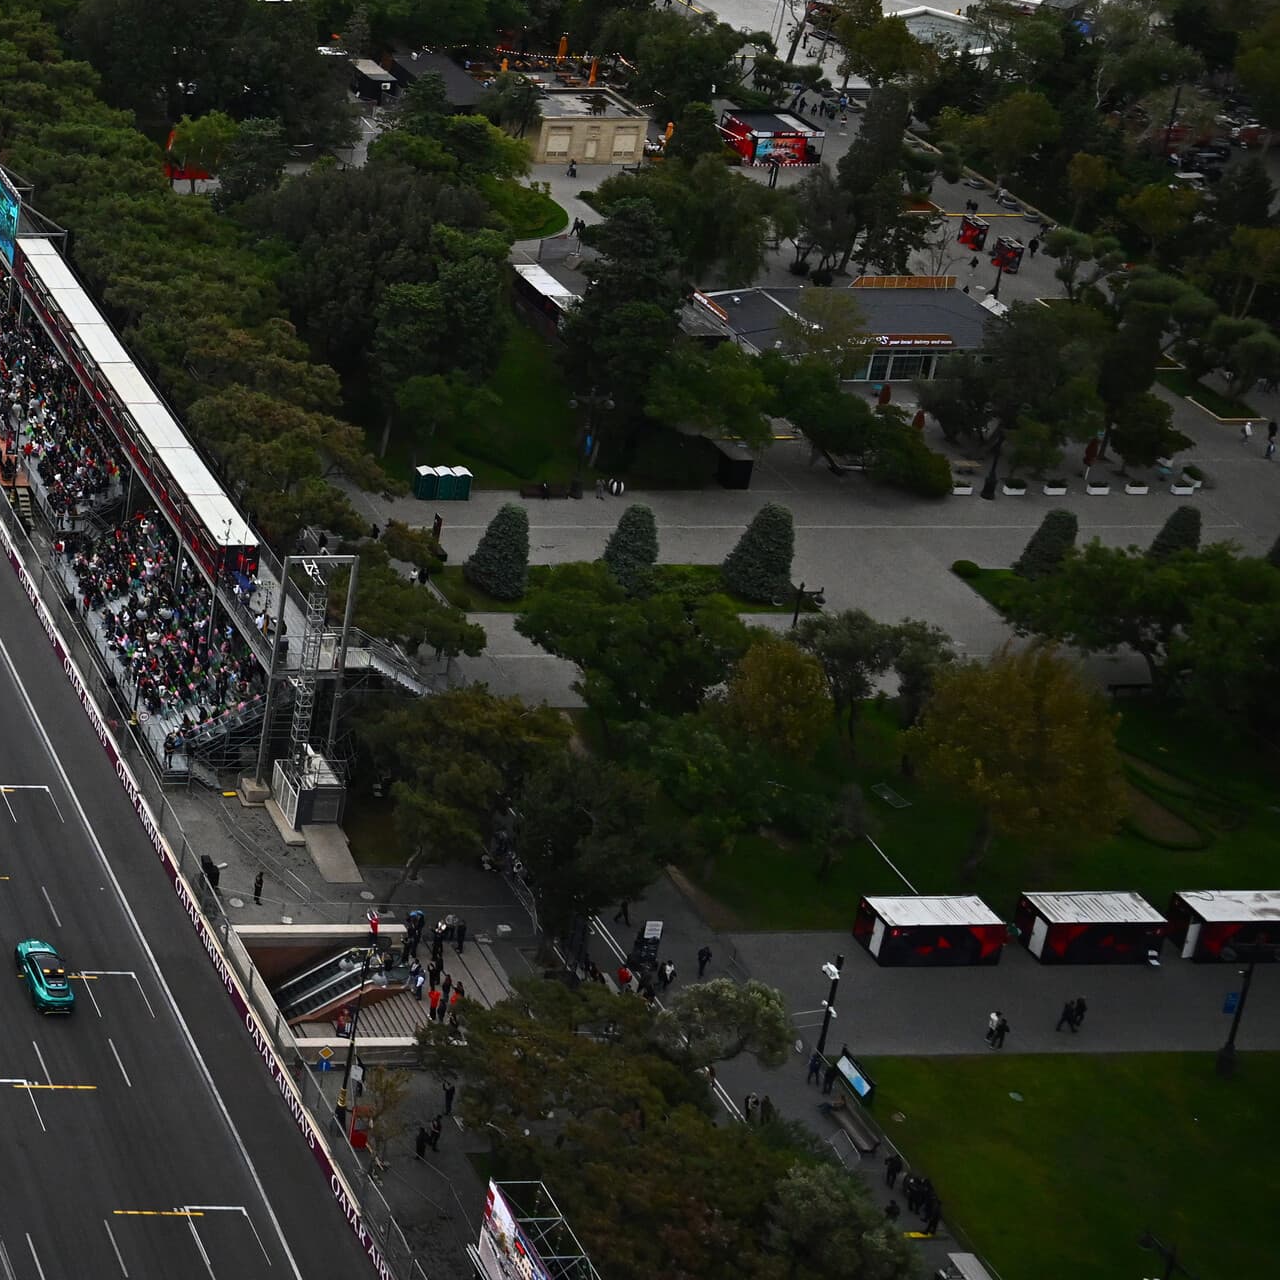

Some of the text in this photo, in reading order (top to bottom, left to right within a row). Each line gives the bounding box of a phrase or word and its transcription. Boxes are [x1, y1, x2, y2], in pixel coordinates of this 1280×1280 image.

[17, 566, 58, 648] QATAR AIRWAYS
[63, 656, 109, 748] QATAR AIRWAYS
[114, 759, 167, 862] QATAR AIRWAYS
[174, 876, 234, 995] QATAR AIRWAYS
[245, 1012, 317, 1151] QATAR AIRWAYS
[330, 1173, 367, 1247] QATAR
